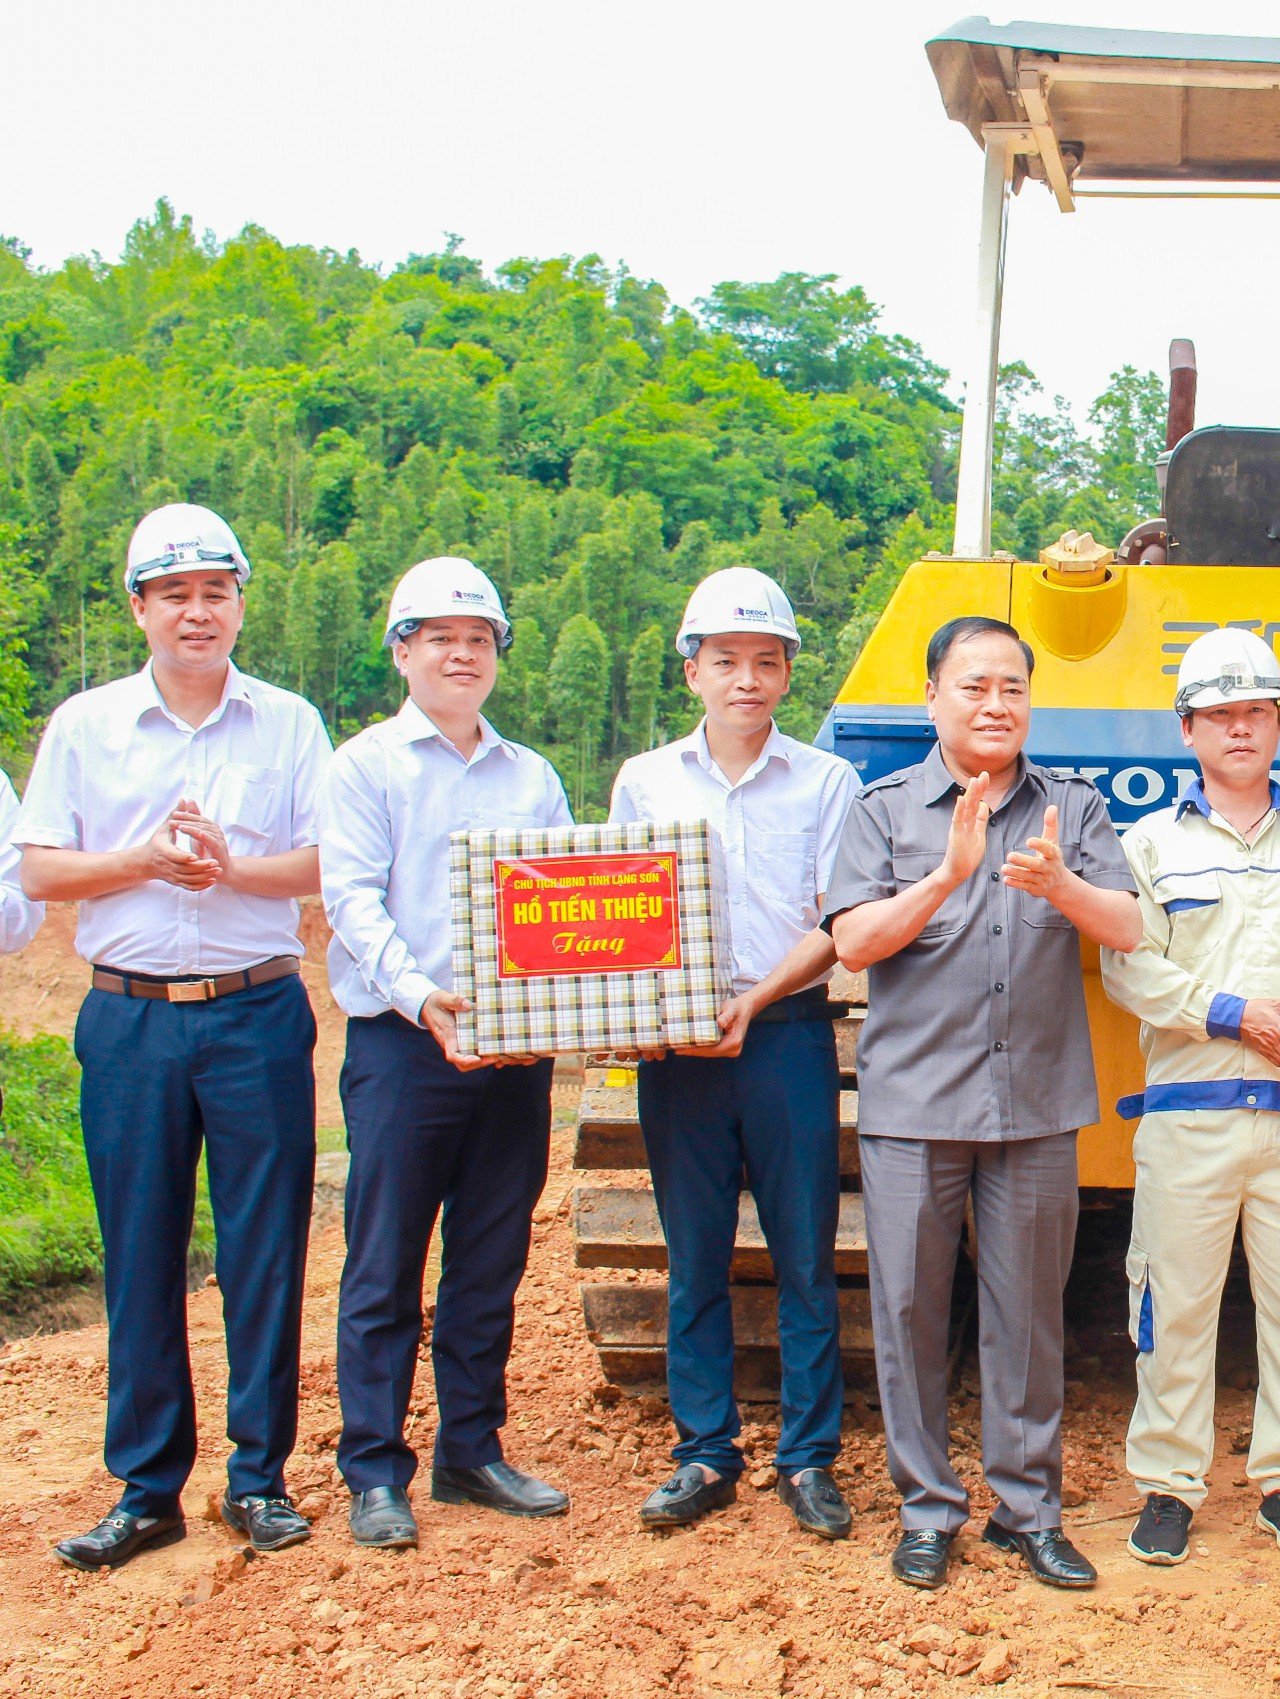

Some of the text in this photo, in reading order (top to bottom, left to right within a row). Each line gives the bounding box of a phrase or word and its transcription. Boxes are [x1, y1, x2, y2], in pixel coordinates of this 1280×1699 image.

[514, 876, 533, 890] CHỦ
[560, 876, 585, 888] UBND
[639, 872, 659, 884] SƠN
[513, 891, 663, 925] HỒ TIẾN THIỆU
[552, 932, 626, 957] Tặng
